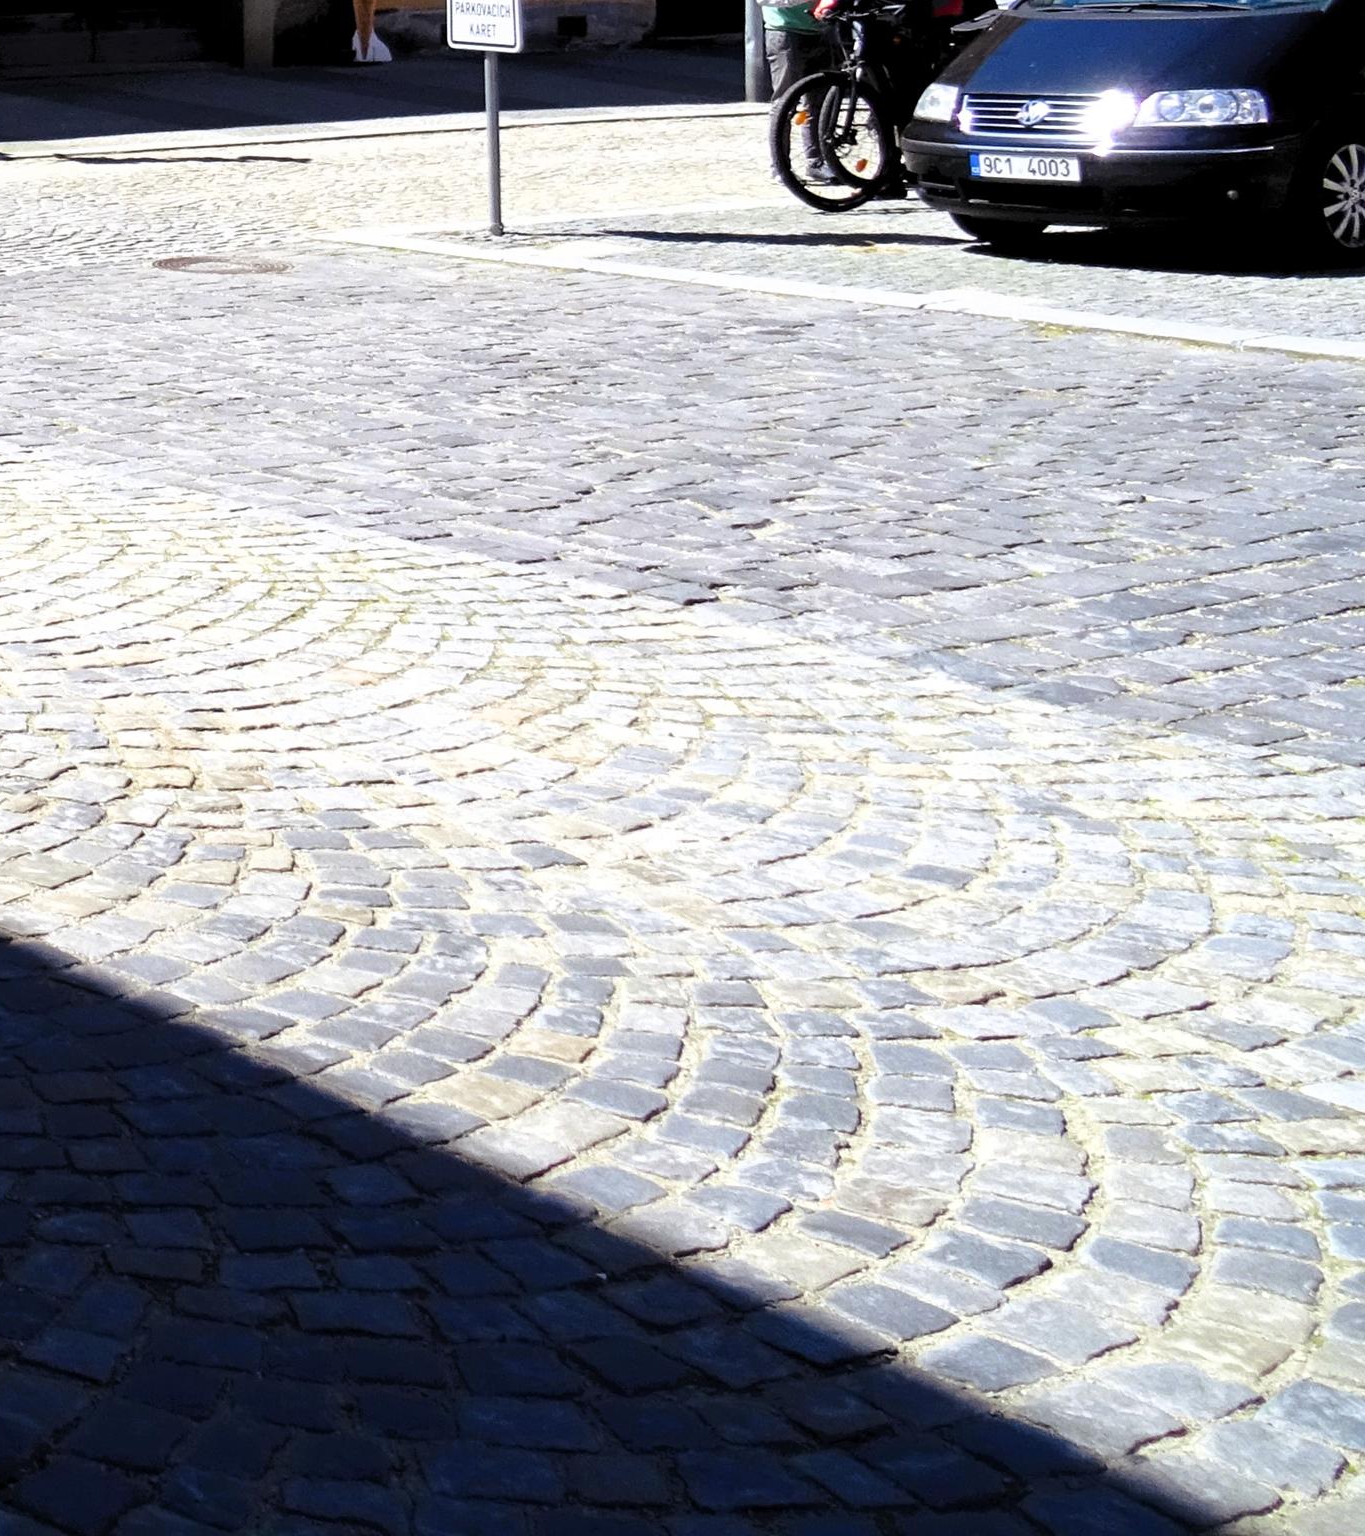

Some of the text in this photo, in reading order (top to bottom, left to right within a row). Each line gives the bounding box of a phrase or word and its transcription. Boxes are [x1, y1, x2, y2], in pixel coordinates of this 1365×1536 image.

[469, 23, 496, 38] KARET
[983, 156, 1013, 175] 9C1
[1027, 158, 1070, 177] 4003
